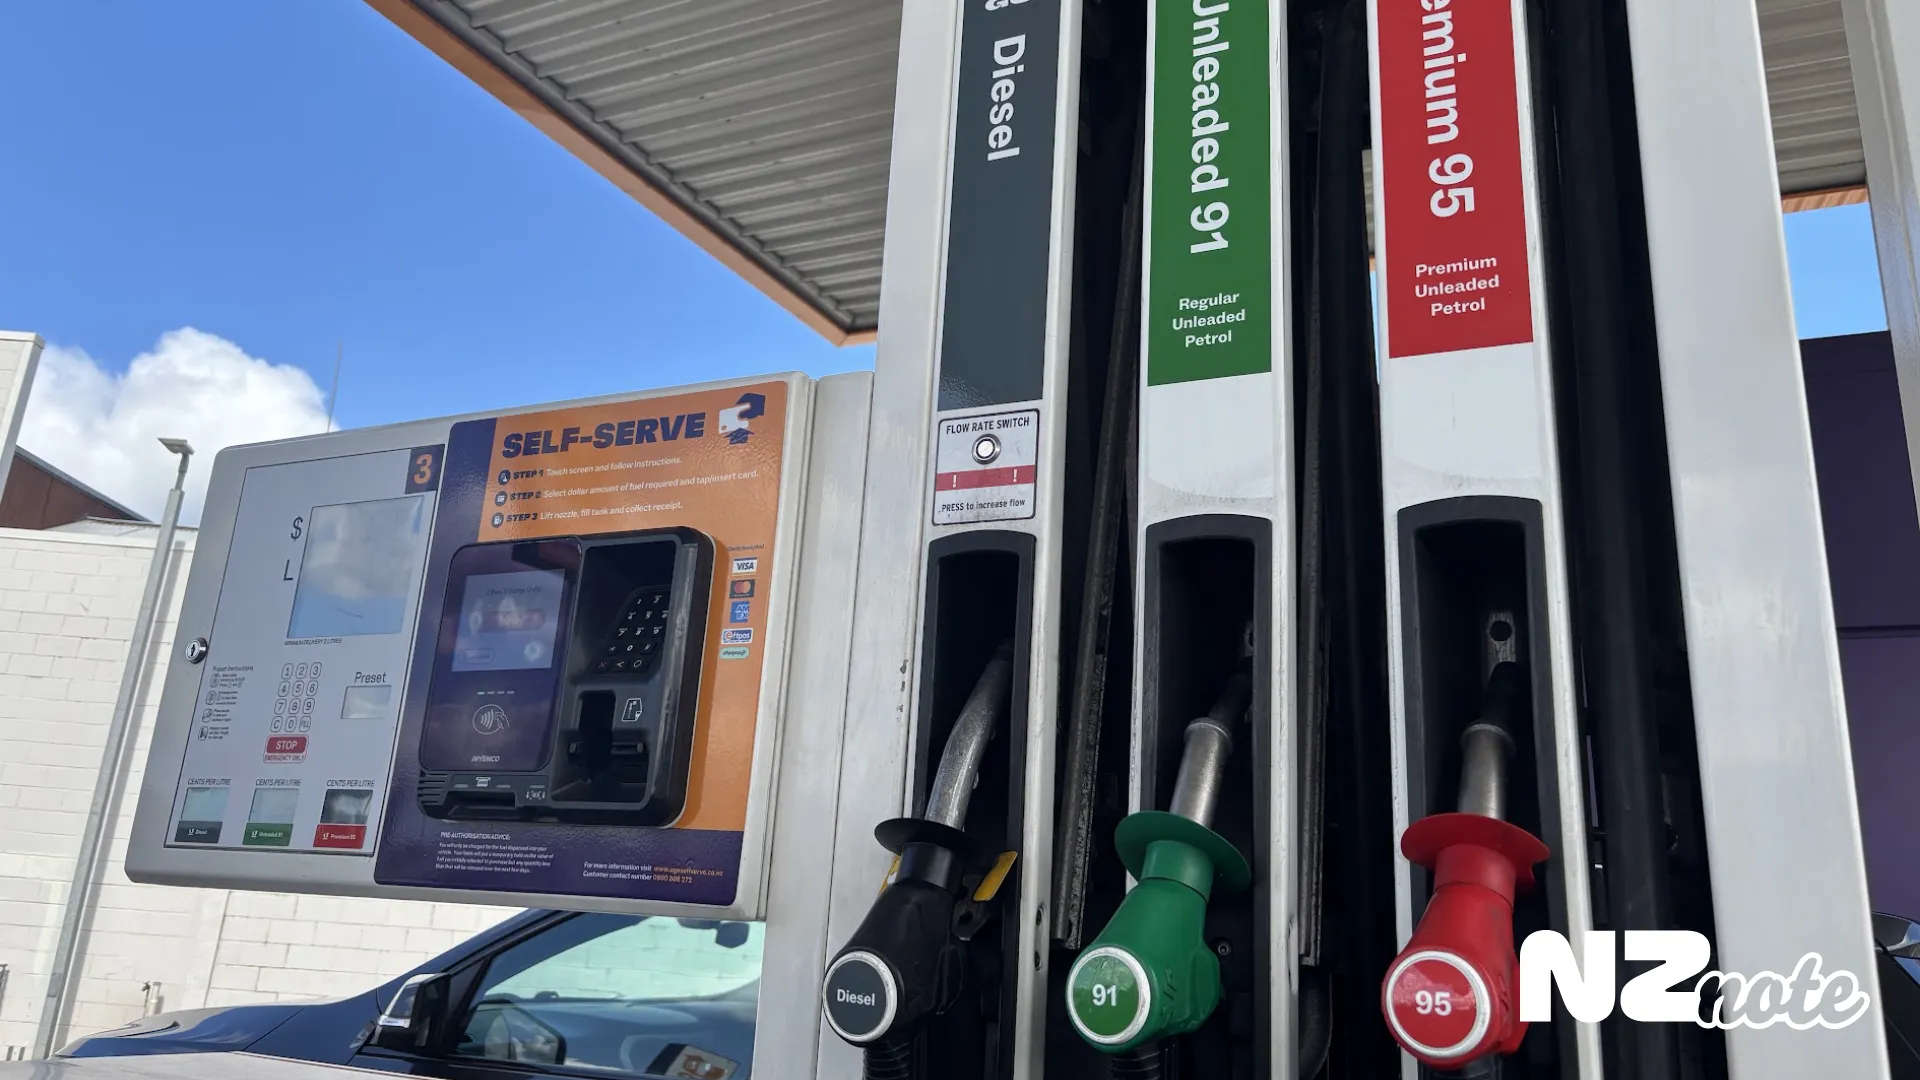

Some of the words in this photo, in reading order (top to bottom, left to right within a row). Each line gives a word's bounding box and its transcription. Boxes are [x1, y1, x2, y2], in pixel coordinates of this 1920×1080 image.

[987, 34, 1026, 161] Diesel
[1428, 153, 1475, 218] 95
[1190, 200, 1230, 253] 91
[1415, 255, 1497, 277] Premium
[1414, 274, 1500, 298] Unleaded
[1178, 291, 1240, 311] Regular
[1430, 297, 1486, 317] Petrol
[1172, 309, 1246, 331] Unleaded
[1184, 330, 1232, 348] Petrol
[502, 412, 706, 458] SELF-SERVE
[946, 422, 970, 435] FLOW
[972, 420, 994, 432] RATE
[997, 416, 1030, 430] SWITCH
[413, 453, 433, 485] 3
[513, 469, 537, 479] STEP
[546, 466, 567, 476] Touch
[568, 464, 593, 475] screen
[594, 463, 609, 471] and
[610, 460, 633, 470] follow
[634, 456, 682, 468] instructions.
[510, 491, 533, 501] STEP
[543, 488, 566, 498] Select
[567, 485, 588, 496] dollar
[589, 485, 618, 495] amount
[620, 483, 627, 491] of
[629, 481, 644, 490] fuel
[645, 478, 678, 490] required
[679, 476, 695, 485] and
[696, 472, 735, 485] tap/insert
[736, 470, 758, 480] card.
[506, 513, 530, 523] STEP
[531, 512, 538, 520] 3
[539, 510, 553, 519] Lift
[553, 508, 579, 521] nozzle,
[580, 507, 590, 516] fill
[591, 507, 609, 516] tank
[609, 506, 624, 514] and
[625, 502, 653, 513] collect
[653, 499, 683, 512] receipt.
[941, 502, 964, 512] PRESS
[966, 502, 975, 510] to
[976, 499, 1008, 510] increase
[1010, 498, 1026, 507] flow
[290, 516, 304, 542] $
[283, 559, 294, 581] L
[736, 562, 755, 571] VISA
[298, 666, 305, 676] 2
[312, 666, 319, 675] 3
[354, 671, 387, 684] Preset
[281, 684, 287, 693] 4
[295, 684, 301, 693] 5
[309, 684, 315, 693] 6
[278, 702, 284, 711] 7
[292, 702, 298, 710] 8
[306, 701, 312, 710] 9
[274, 719, 280, 729] C
[288, 719, 294, 729] 0
[275, 740, 298, 751] STOP
[187, 778, 205, 786] CENTS
[205, 778, 216, 786] PER
[216, 778, 232, 786] LITRE
[255, 778, 273, 787] CENTS
[273, 778, 285, 787] PER
[285, 778, 302, 787] LITRE
[326, 779, 346, 788] CENTS
[346, 779, 358, 788] PER
[358, 779, 375, 788] LITRE
[582, 870, 608, 878] Customer
[608, 862, 639, 871] information
[836, 988, 876, 1006] Diesel
[1091, 983, 1118, 1007] 91
[1414, 989, 1453, 1017] 95
